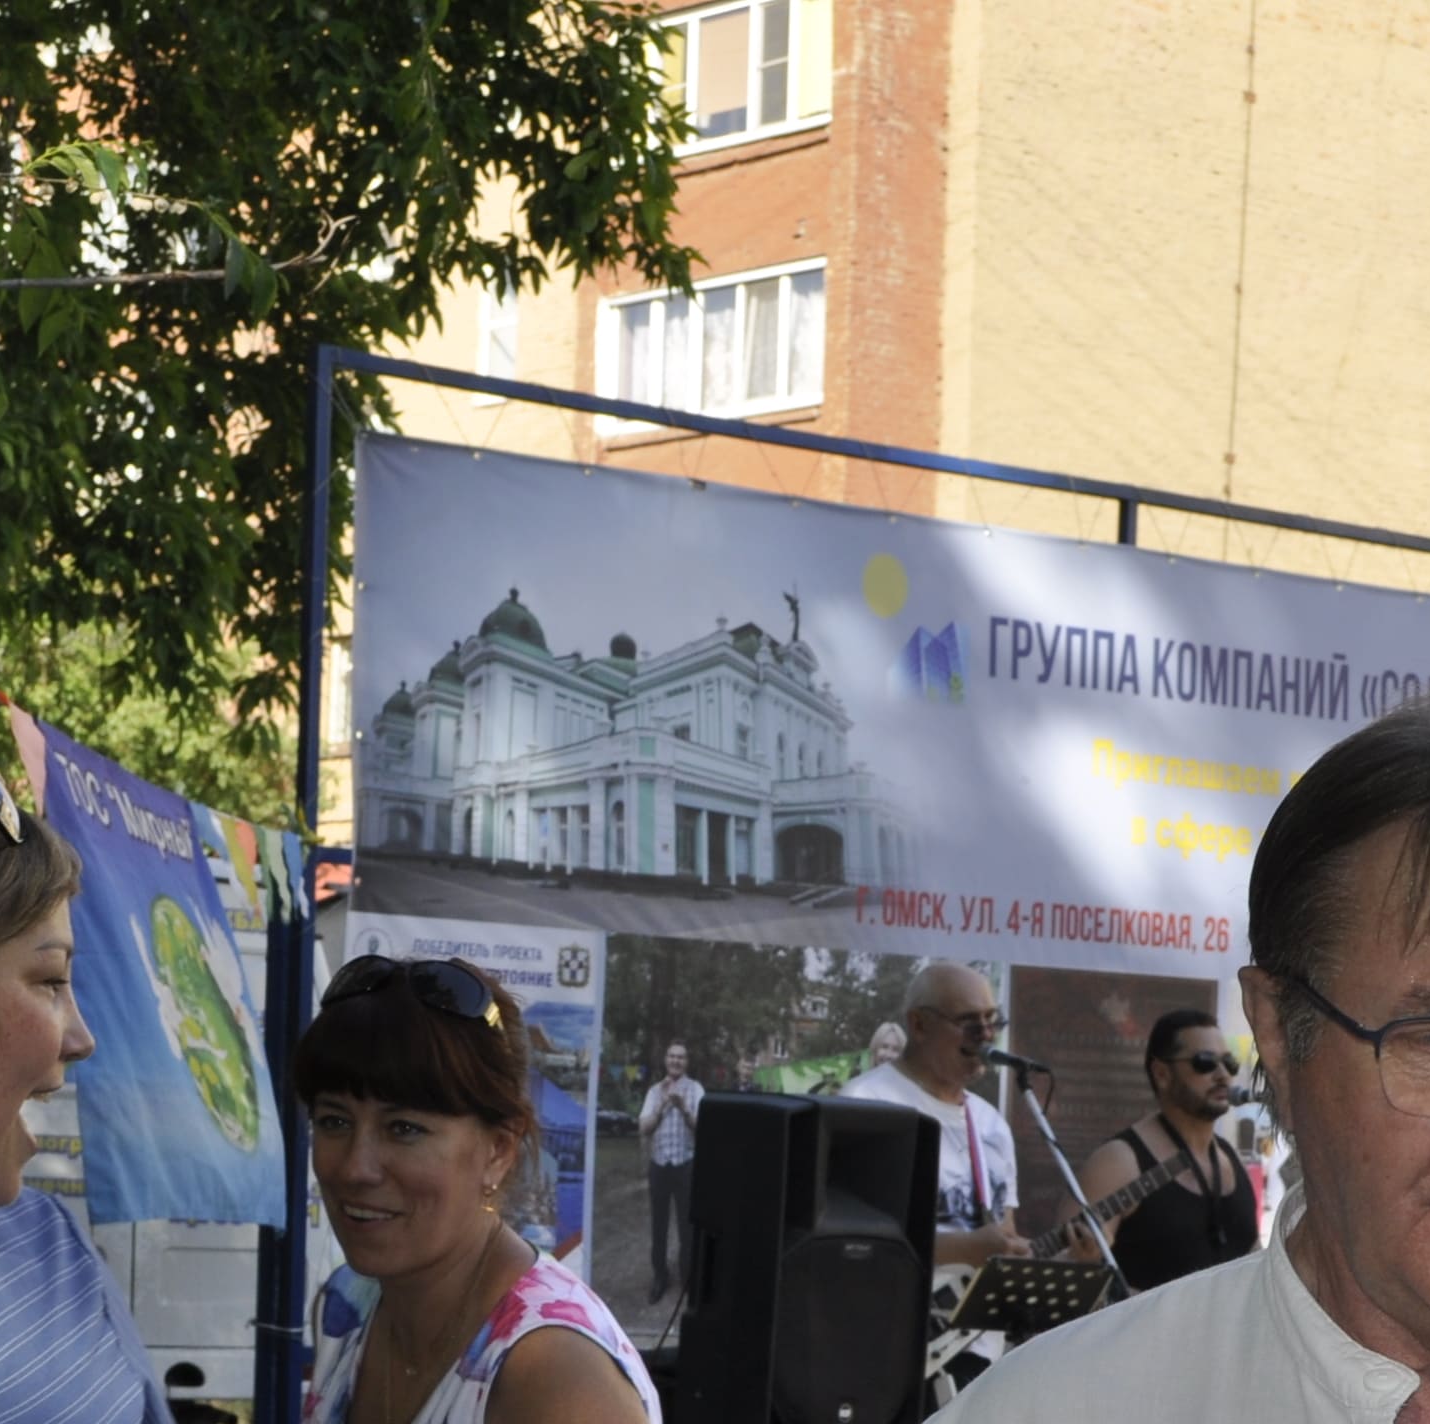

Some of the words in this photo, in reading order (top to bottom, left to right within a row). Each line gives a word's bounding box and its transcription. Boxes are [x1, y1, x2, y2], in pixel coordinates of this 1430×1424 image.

[988, 615, 1140, 696] ГРУППА
[1151, 636, 1350, 722] КОМПАНИЙ
[52, 751, 111, 826] ТОС
[1091, 736, 1282, 797] Приглашаем
[1154, 810, 1253, 863] сфере
[412, 938, 490, 959] ПОБЕДИТЕЛЬ
[493, 943, 543, 962] ПРОЕКТА
[881, 888, 952, 935] ОМСК,
[959, 894, 1000, 935] УЛ.
[1006, 900, 1044, 939] 4-Я
[1050, 902, 1198, 954] ПОСЕЛКОВАЯ,
[1203, 916, 1230, 953] 26
